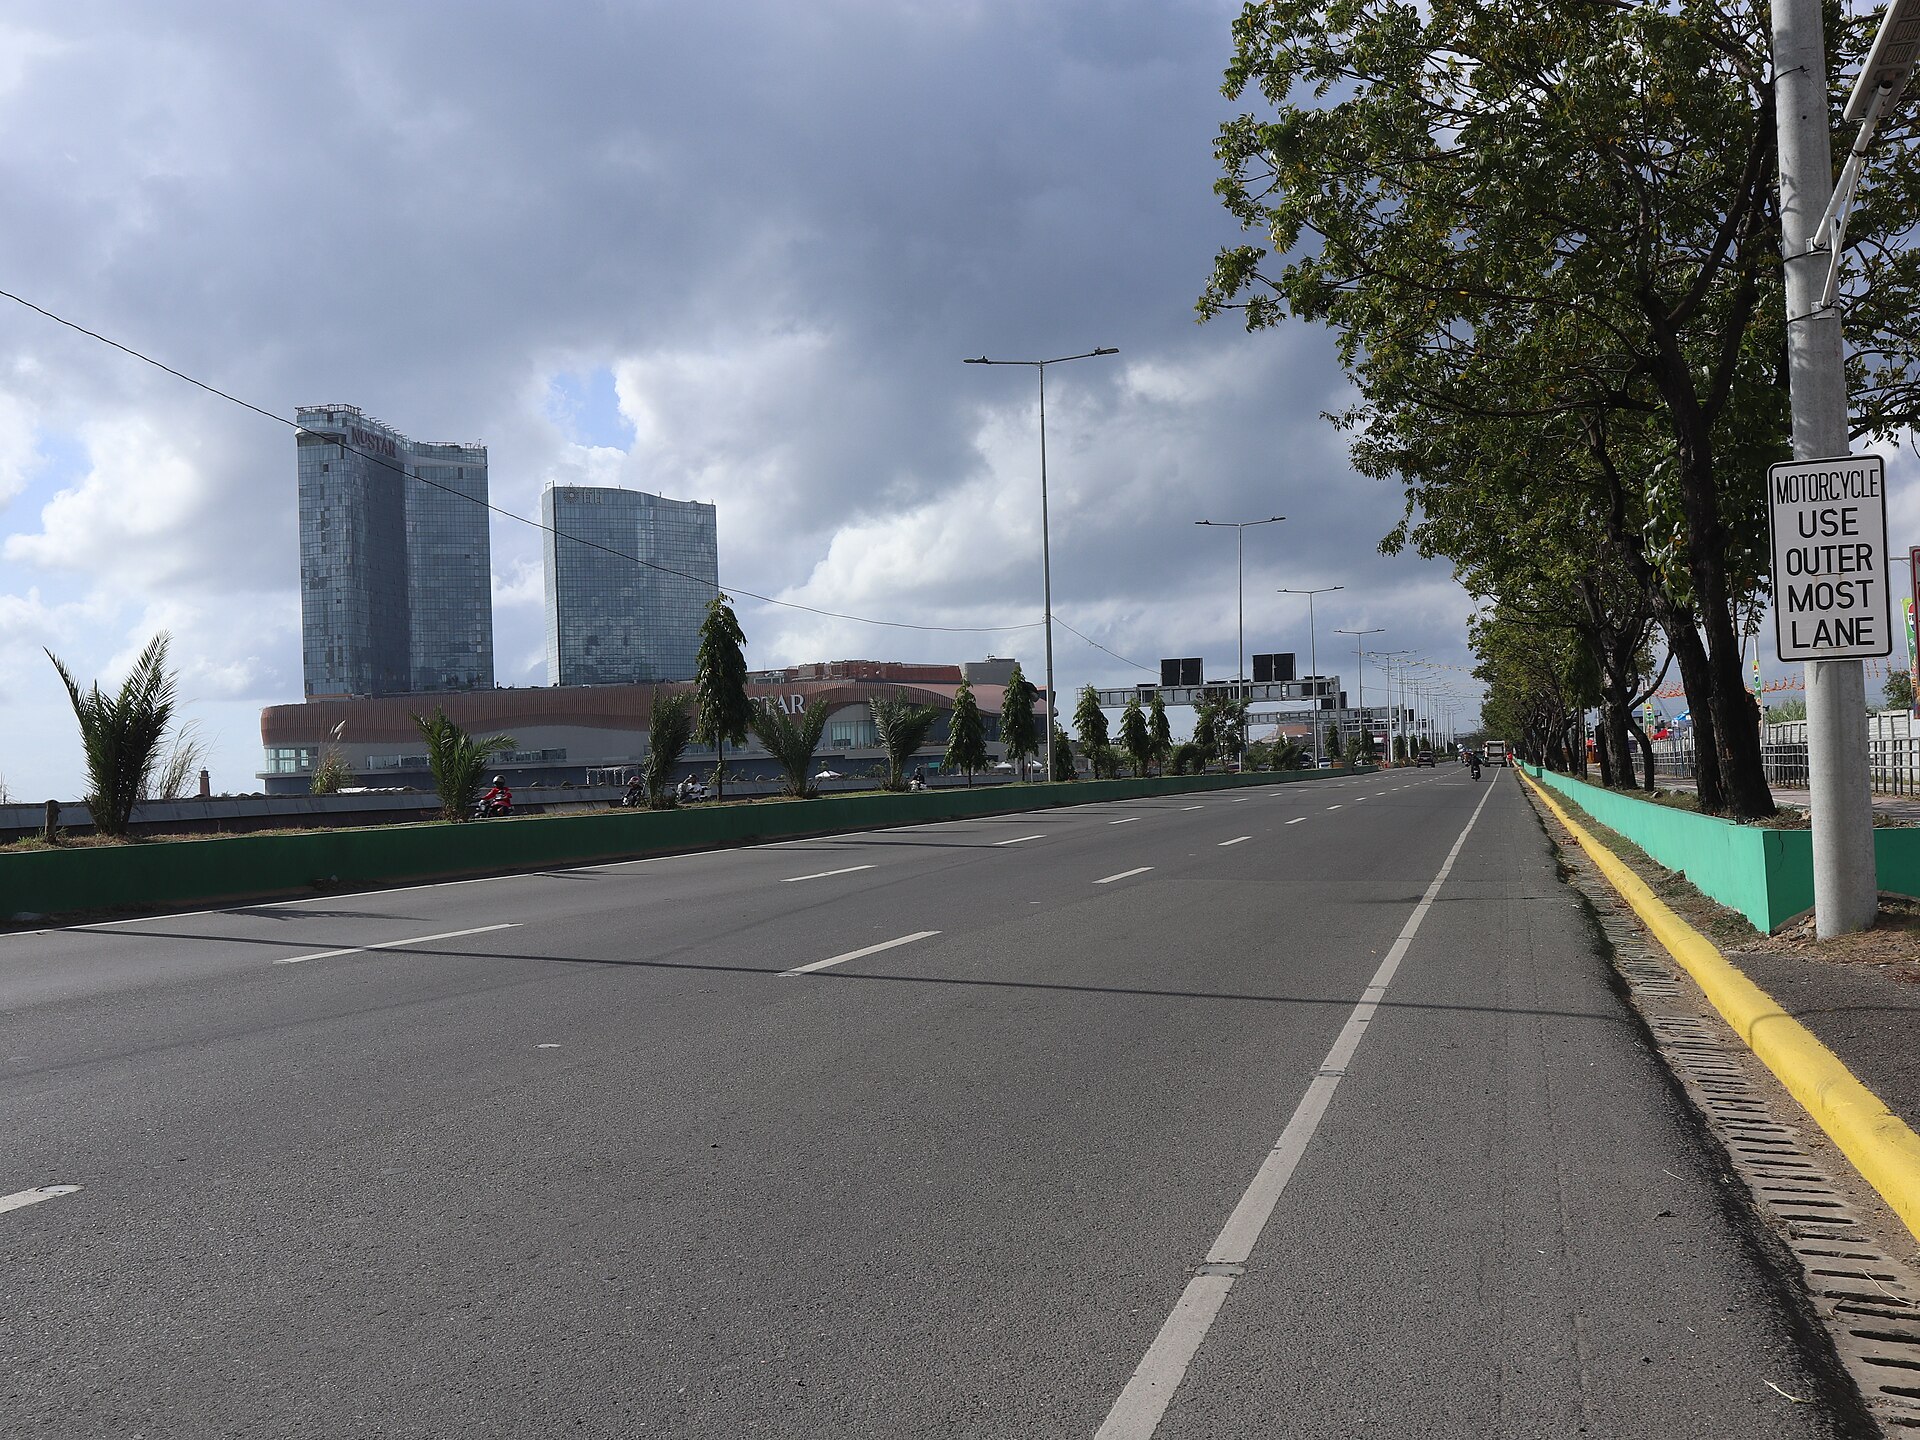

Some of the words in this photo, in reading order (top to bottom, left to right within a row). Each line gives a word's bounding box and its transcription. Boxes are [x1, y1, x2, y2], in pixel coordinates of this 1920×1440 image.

[351, 427, 396, 458] NUSTAR
[1776, 469, 1879, 504] MOTORCYCLE
[1798, 507, 1859, 538] USE
[1786, 543, 1873, 576] OUTER
[1788, 579, 1874, 612] MOST
[1791, 617, 1875, 649] LANE
